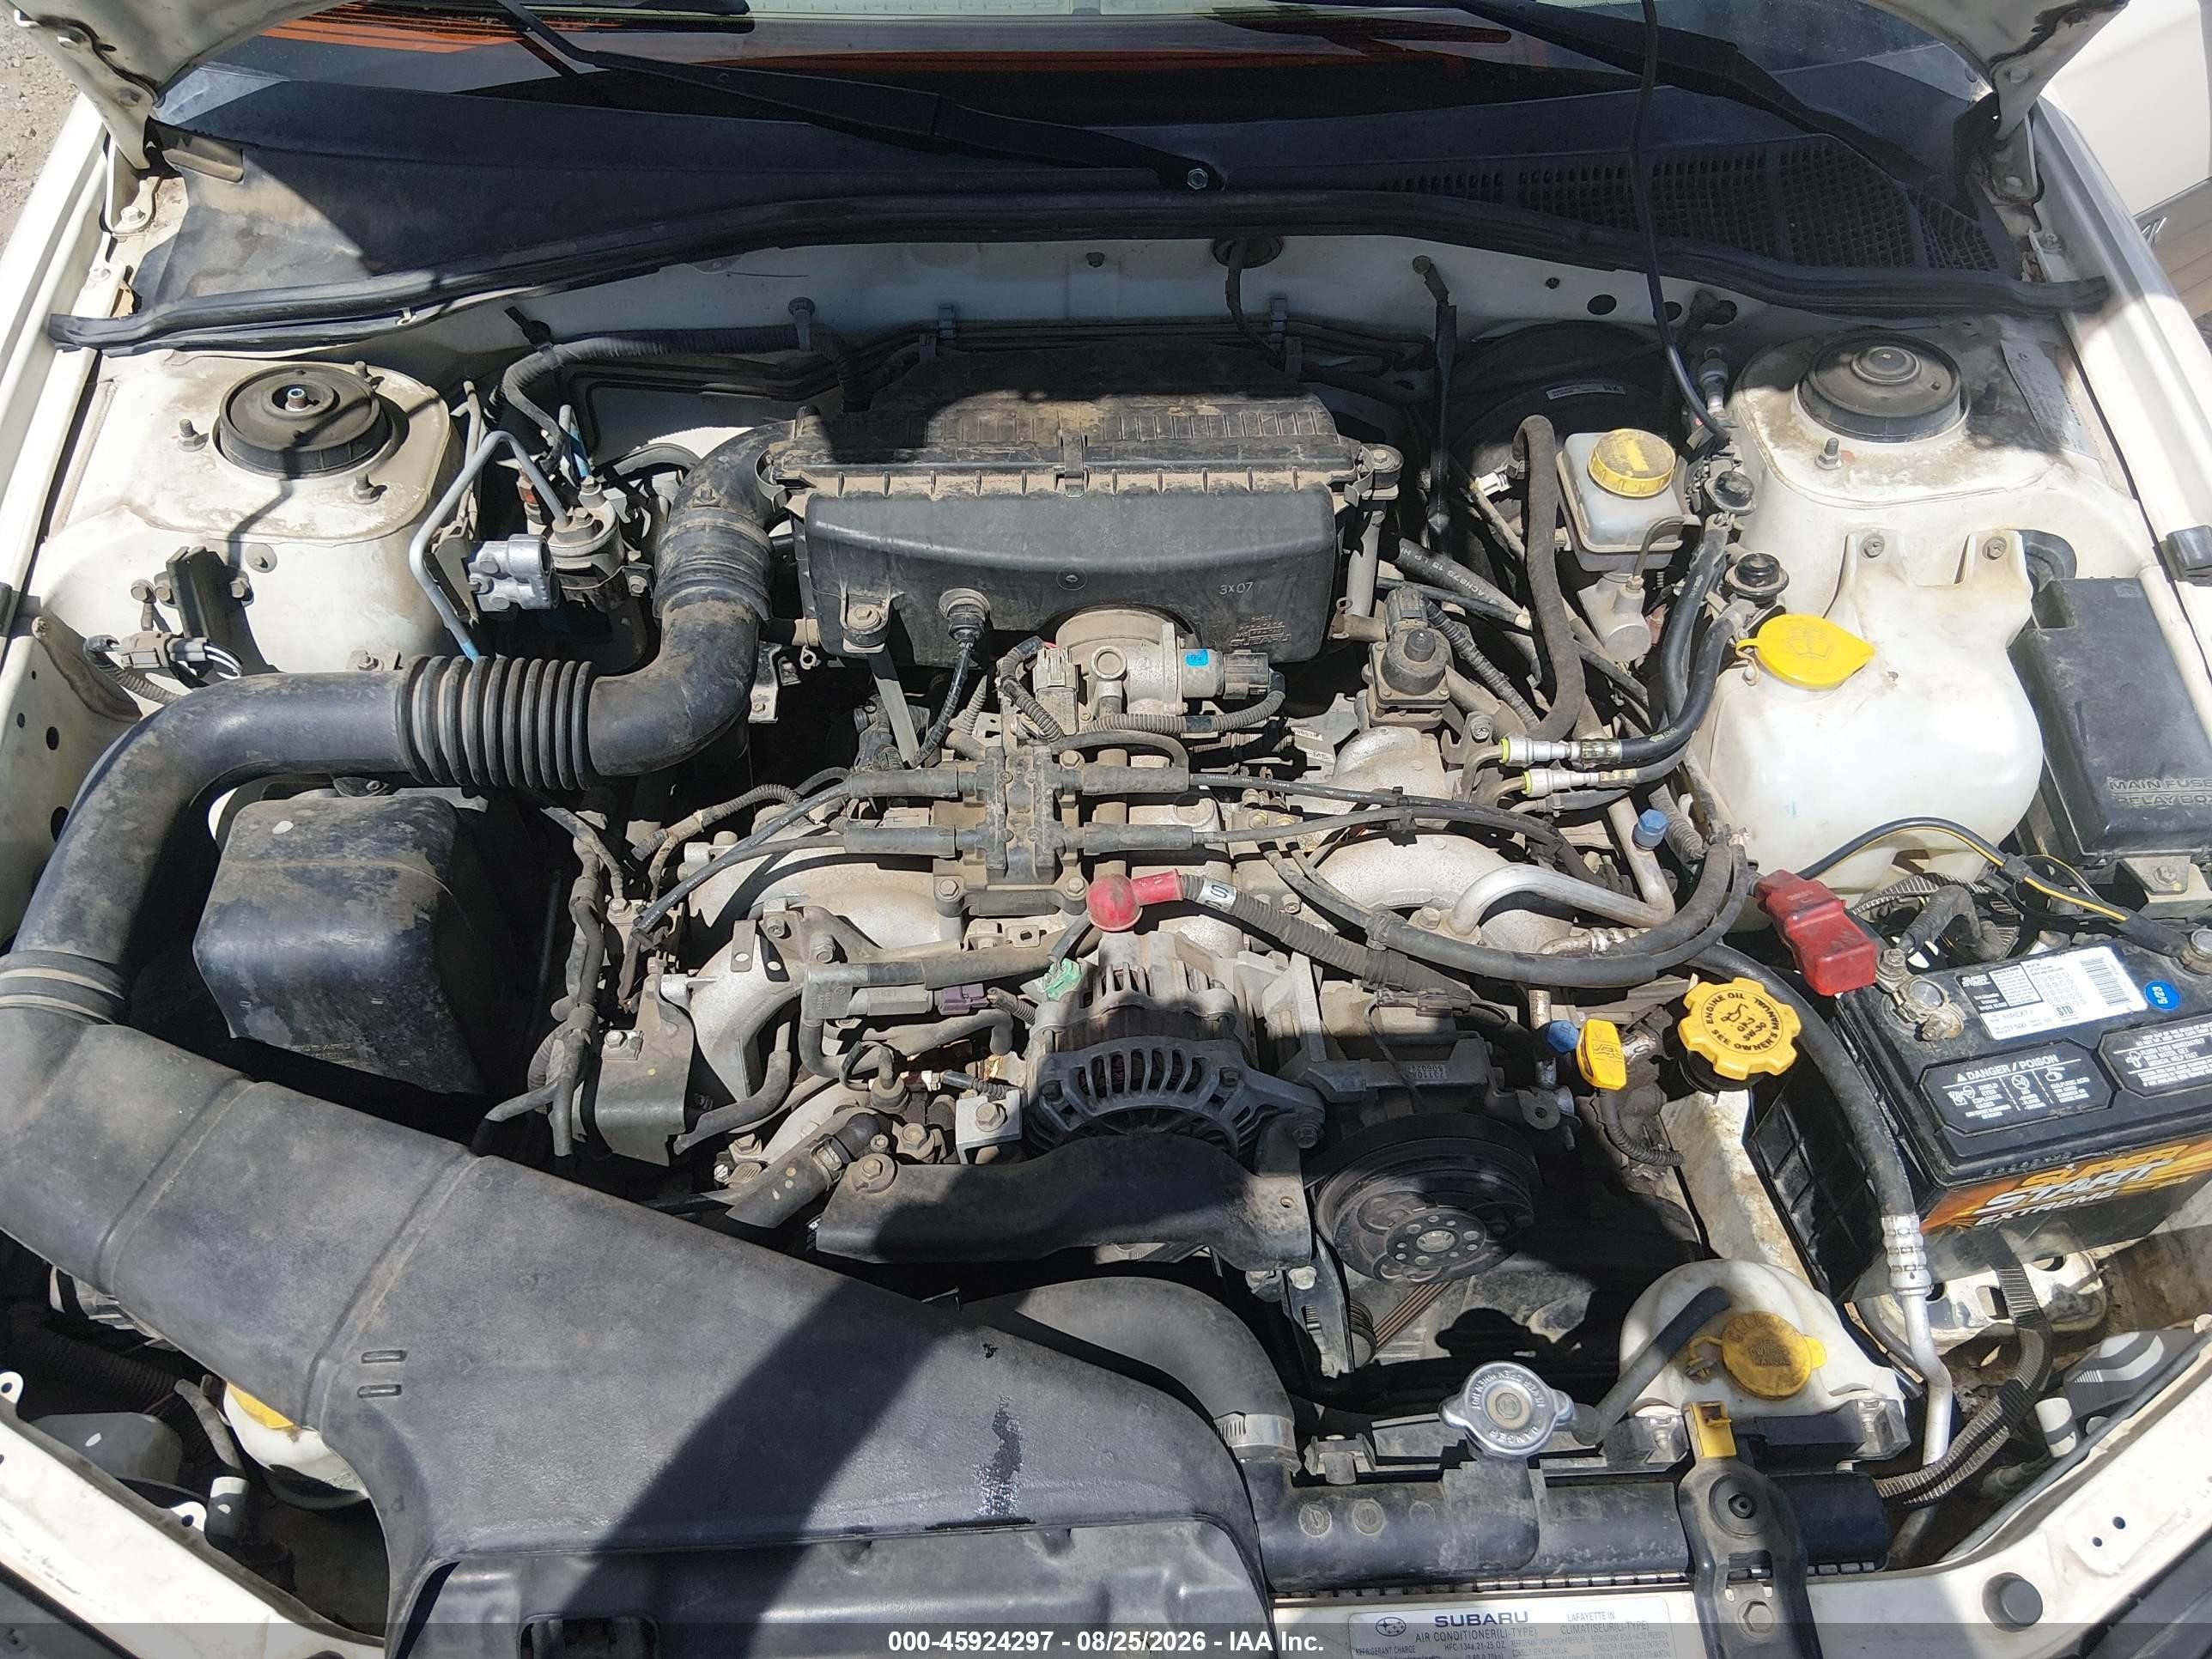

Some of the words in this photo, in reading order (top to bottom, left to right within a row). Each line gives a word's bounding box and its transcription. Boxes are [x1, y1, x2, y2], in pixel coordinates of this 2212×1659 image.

[2108, 779, 2161, 791] MAIN
[1705, 992, 1726, 1024] ENGINE
[1753, 996, 1780, 1030] MANUAL
[2057, 1005, 2074, 1017] STD
[1711, 1029, 1732, 1045] SEE
[1733, 1032, 1778, 1051] OWNER'S
[1742, 1022, 1767, 1042] 5W-30
[1965, 1065, 2012, 1080] DANGER
[2011, 1061, 2018, 1073] /
[2020, 1054, 2059, 1070] POISON
[2021, 1145, 2190, 1188] SUPER
[1972, 1158, 2174, 1216] START
[1975, 1188, 2119, 1226] EXTREME
[1488, 1425, 1539, 1444] DANGER
[1434, 1610, 1528, 1628] SUBARU
[1415, 1632, 1431, 1643] AIR
[1496, 1640, 1505, 1649] OZ
[1394, 1645, 1416, 1654] CHARGE
